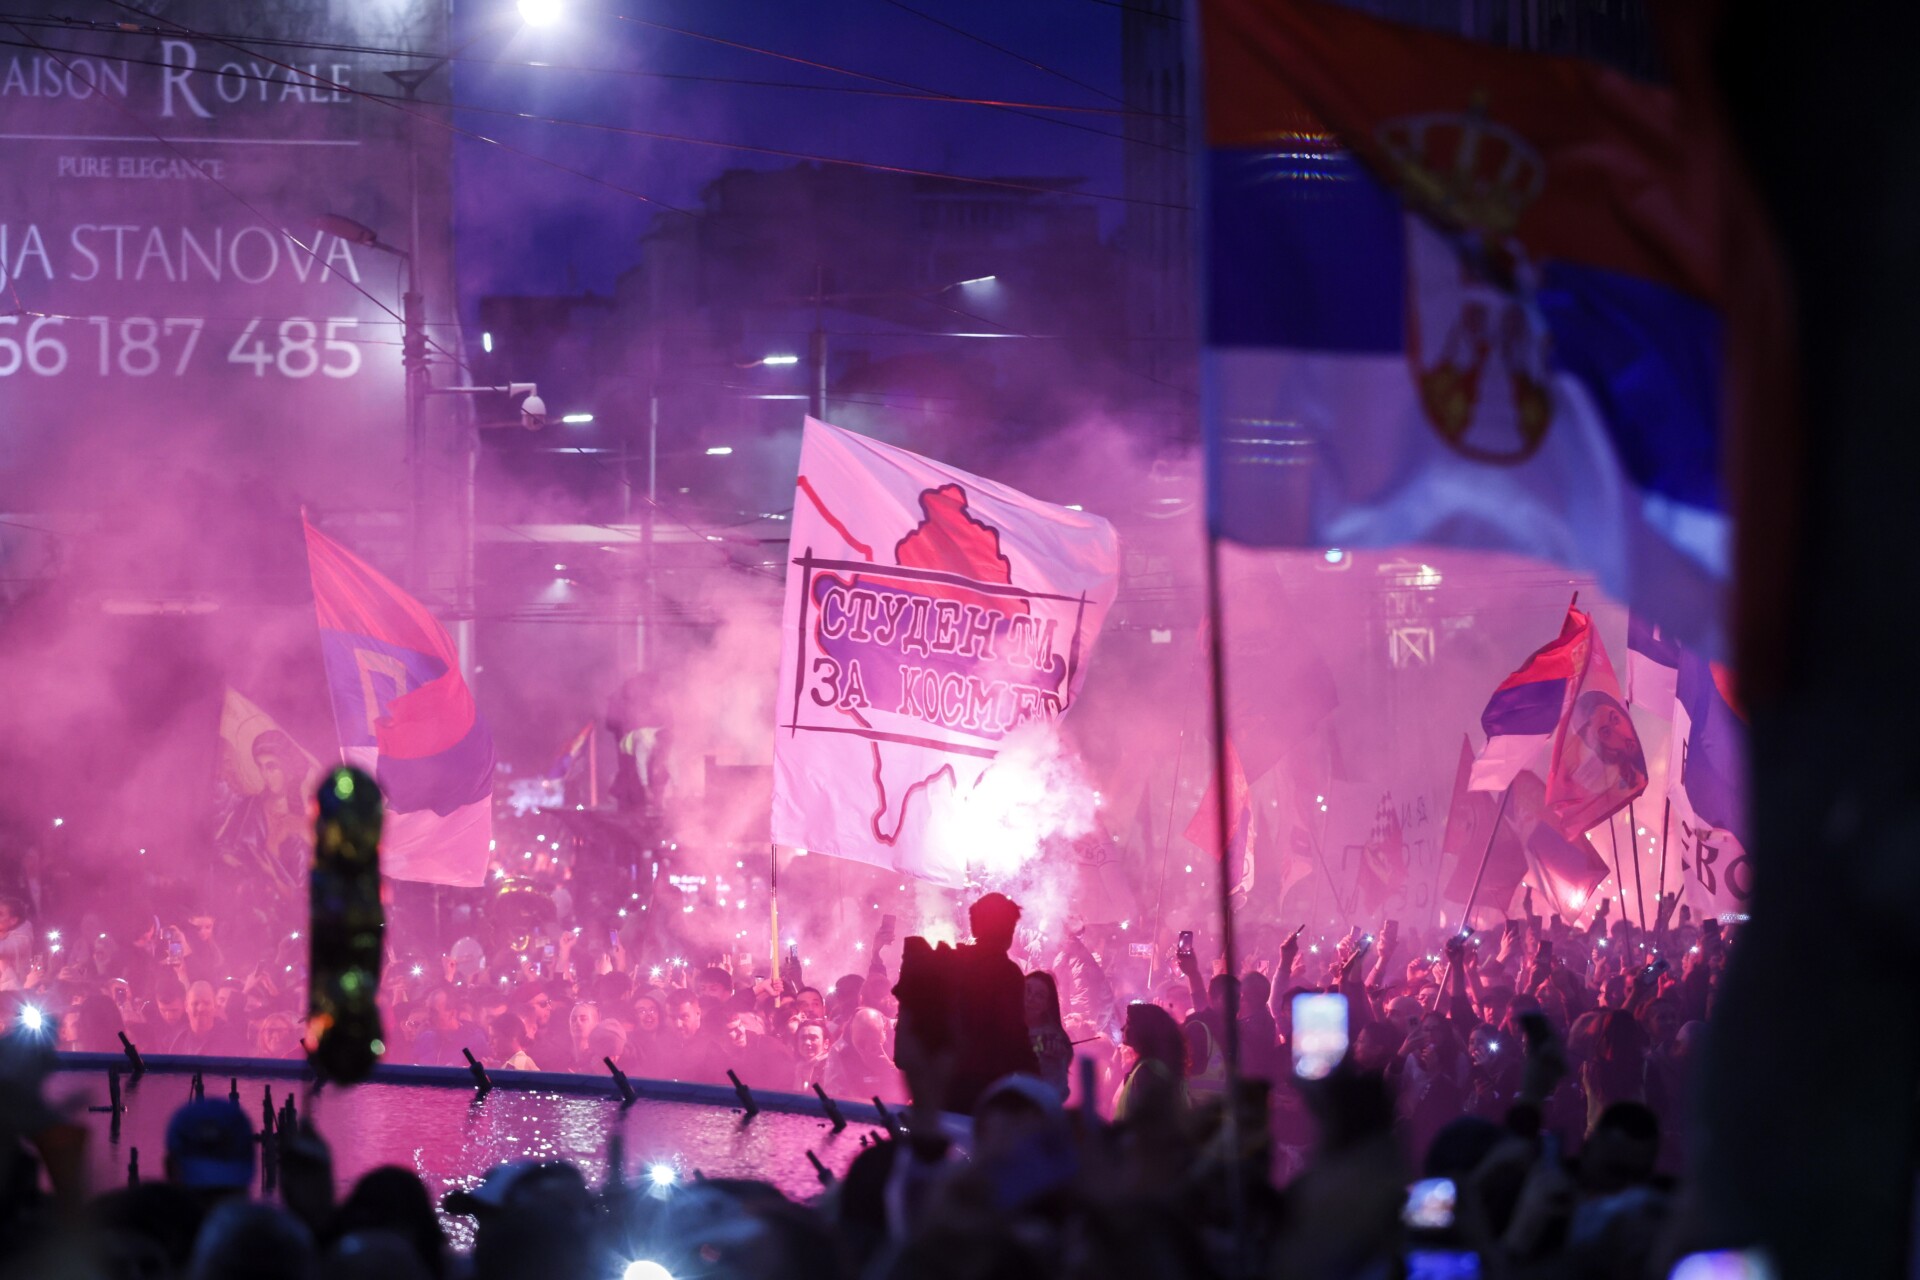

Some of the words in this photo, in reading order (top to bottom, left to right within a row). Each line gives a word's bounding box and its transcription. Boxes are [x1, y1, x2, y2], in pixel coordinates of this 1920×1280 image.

[160, 40, 351, 119] ROYALE
[58, 156, 111, 178] PURE
[117, 156, 225, 180] ELEGANCE
[70, 223, 361, 285] STANOVA
[89, 317, 204, 376] 187
[227, 317, 362, 378] 485
[821, 586, 1059, 673] СТУДЕНТИ
[811, 658, 869, 708] ЗА
